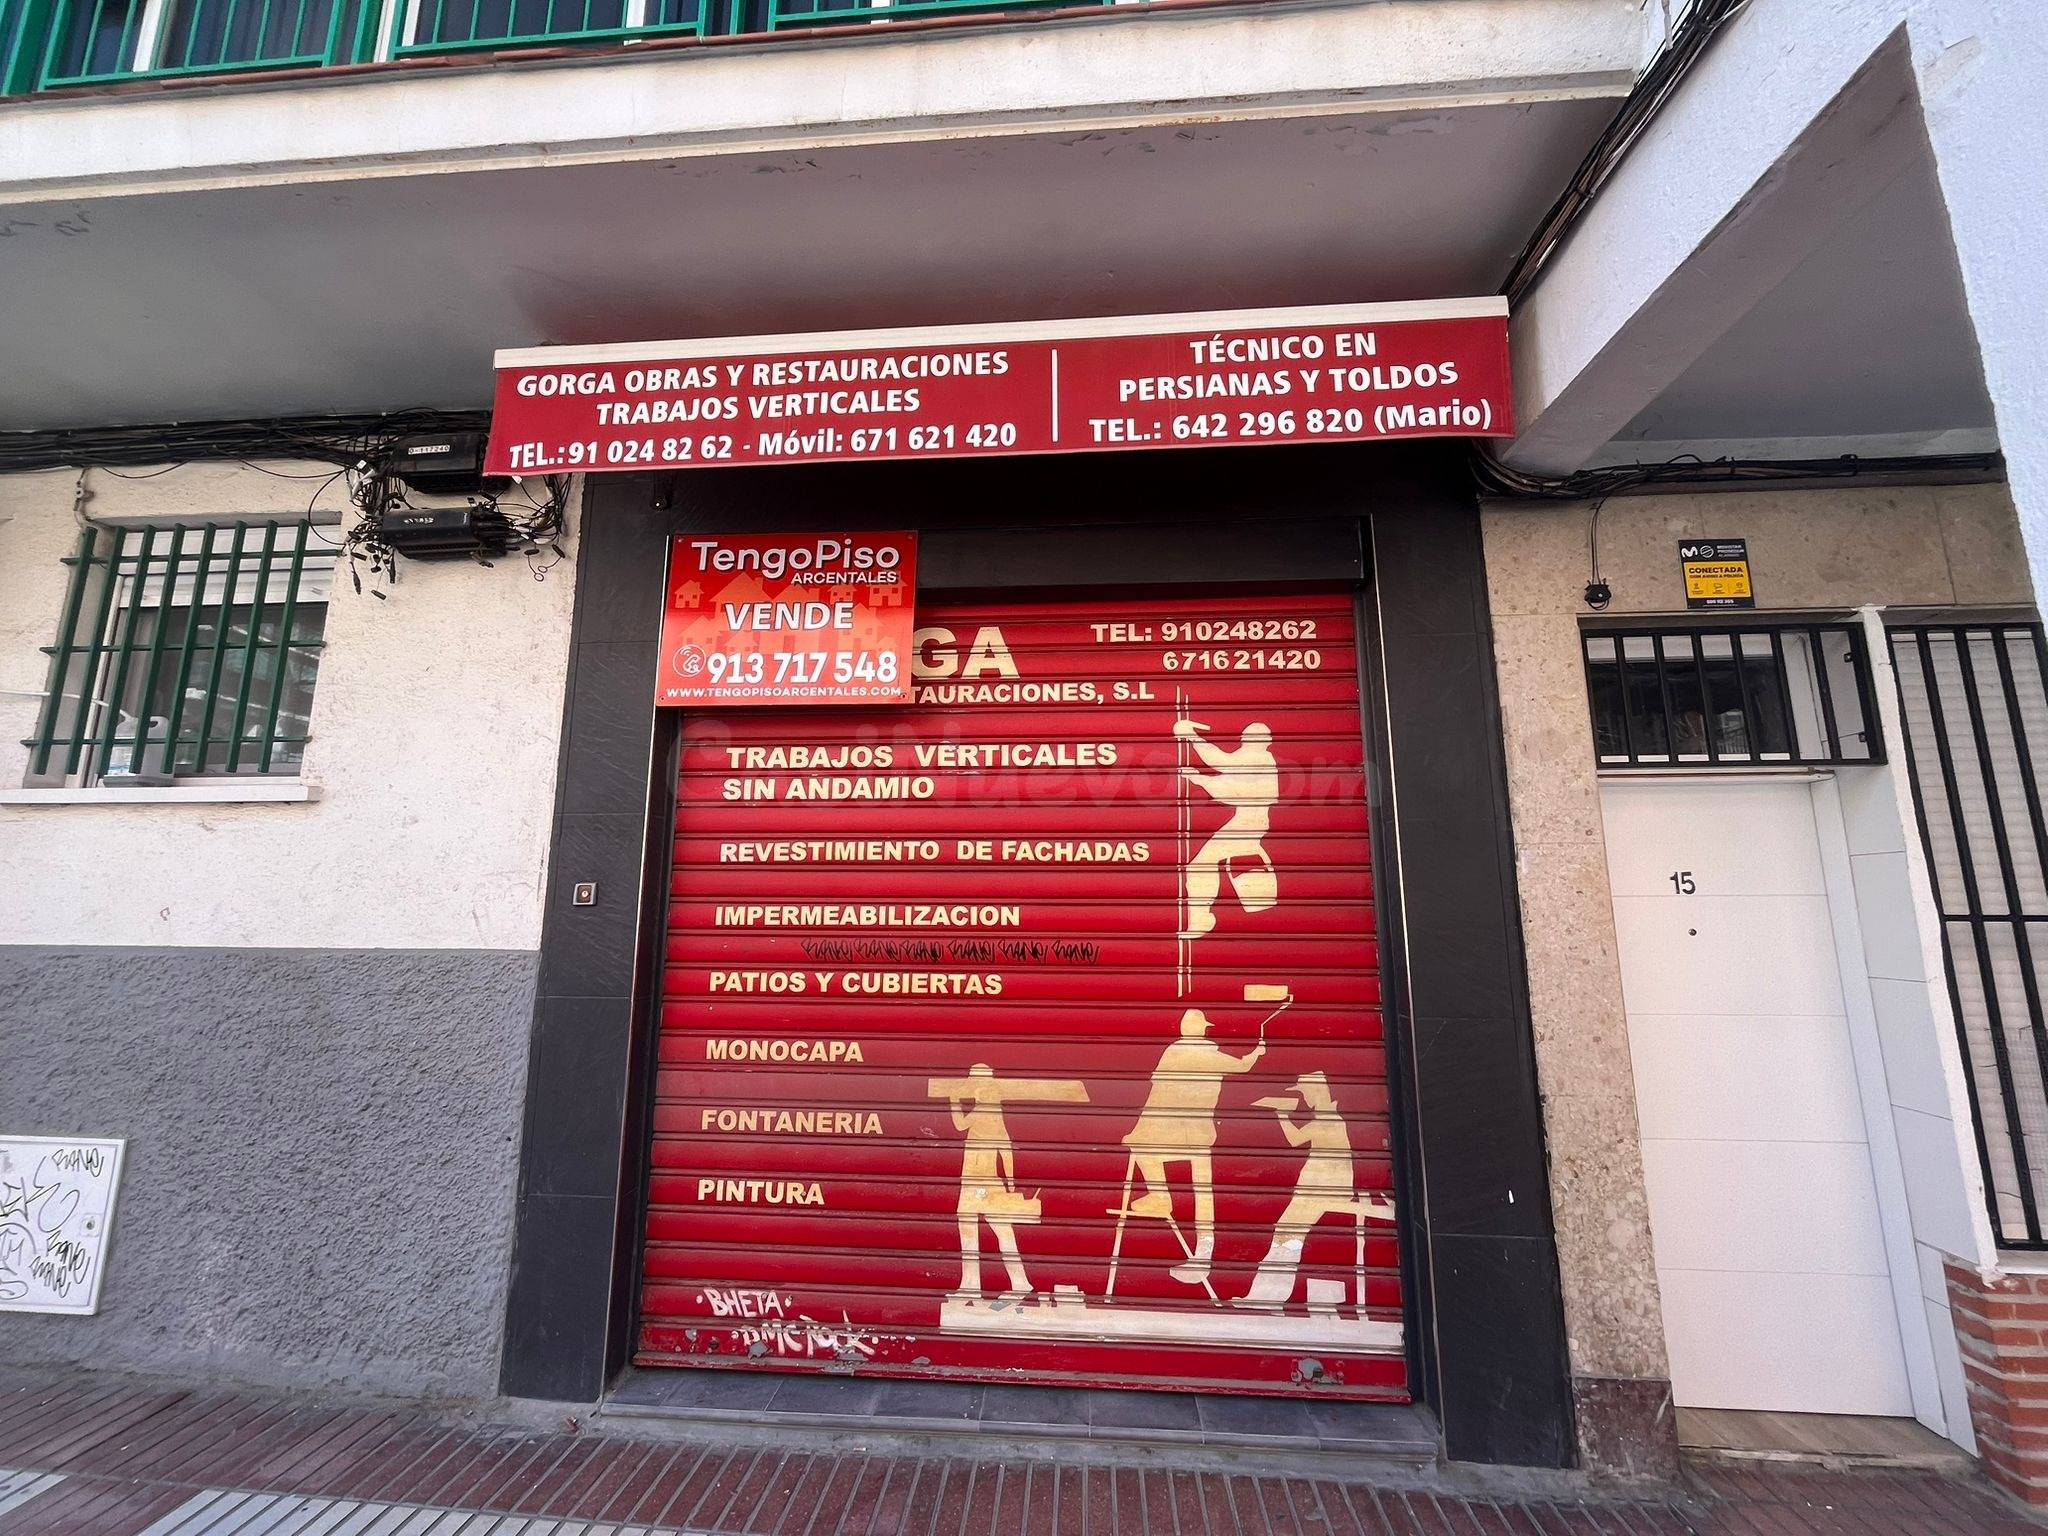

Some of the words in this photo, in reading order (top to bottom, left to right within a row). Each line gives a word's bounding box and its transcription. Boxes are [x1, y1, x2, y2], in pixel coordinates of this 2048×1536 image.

[1189, 333, 1324, 364] TÉCNICO
[1335, 332, 1376, 357] EN
[517, 371, 616, 397] GORGA
[624, 365, 718, 393] OBRAS
[726, 364, 745, 387] Y
[751, 351, 1010, 386] RESTAURACIONES
[1119, 370, 1292, 402] PERSIANAS
[1299, 369, 1320, 393] Y
[1328, 361, 1459, 392] TOLDOS
[596, 397, 739, 426] TRABAJOS
[747, 388, 920, 419] VERTICALES
[1088, 418, 1162, 442] TEL.:
[1172, 413, 1228, 439] 642
[1238, 410, 1296, 436] 296
[1306, 408, 1363, 433] 820
[1373, 398, 1492, 434] (Mario)
[607, 439, 655, 463] 024
[661, 436, 693, 461] 82
[700, 435, 733, 459] 62
[758, 427, 843, 456] Móvil:
[850, 427, 897, 452] 671
[908, 424, 955, 450] 621
[965, 422, 1017, 448] 420
[791, 571, 897, 584] ARCENTALES
[1688, 566, 1743, 574] CONECTADA
[725, 602, 854, 630] VENDE
[1090, 623, 1152, 643] TEL:
[1161, 620, 1317, 642] 910248262
[707, 651, 764, 684] 913
[773, 651, 828, 683] 717
[833, 649, 898, 684] 548
[1162, 649, 1321, 671] 671621420
[667, 686, 902, 698] WWW.TENGOPISOARCENTALES.COM
[1112, 681, 1155, 701] S.L
[725, 745, 894, 769] TRABAJOS
[914, 740, 1118, 767] VERTICALES
[722, 778, 776, 800] SIN
[785, 776, 935, 800] ANDAMIO
[720, 840, 940, 863] REVESTIMIENTO
[957, 840, 993, 861] DE
[1001, 840, 1150, 862] FACHADAS
[1669, 871, 1696, 895] 15
[715, 905, 1020, 926] IMPERMEABILIZACION
[709, 971, 806, 993] PATIOS
[814, 972, 835, 993] Y
[842, 972, 1002, 995] CUBIERTAS
[706, 1039, 864, 1062] MONOCAPA
[701, 1109, 883, 1135] FONTANERIA
[698, 1178, 825, 1205] PINTURA
